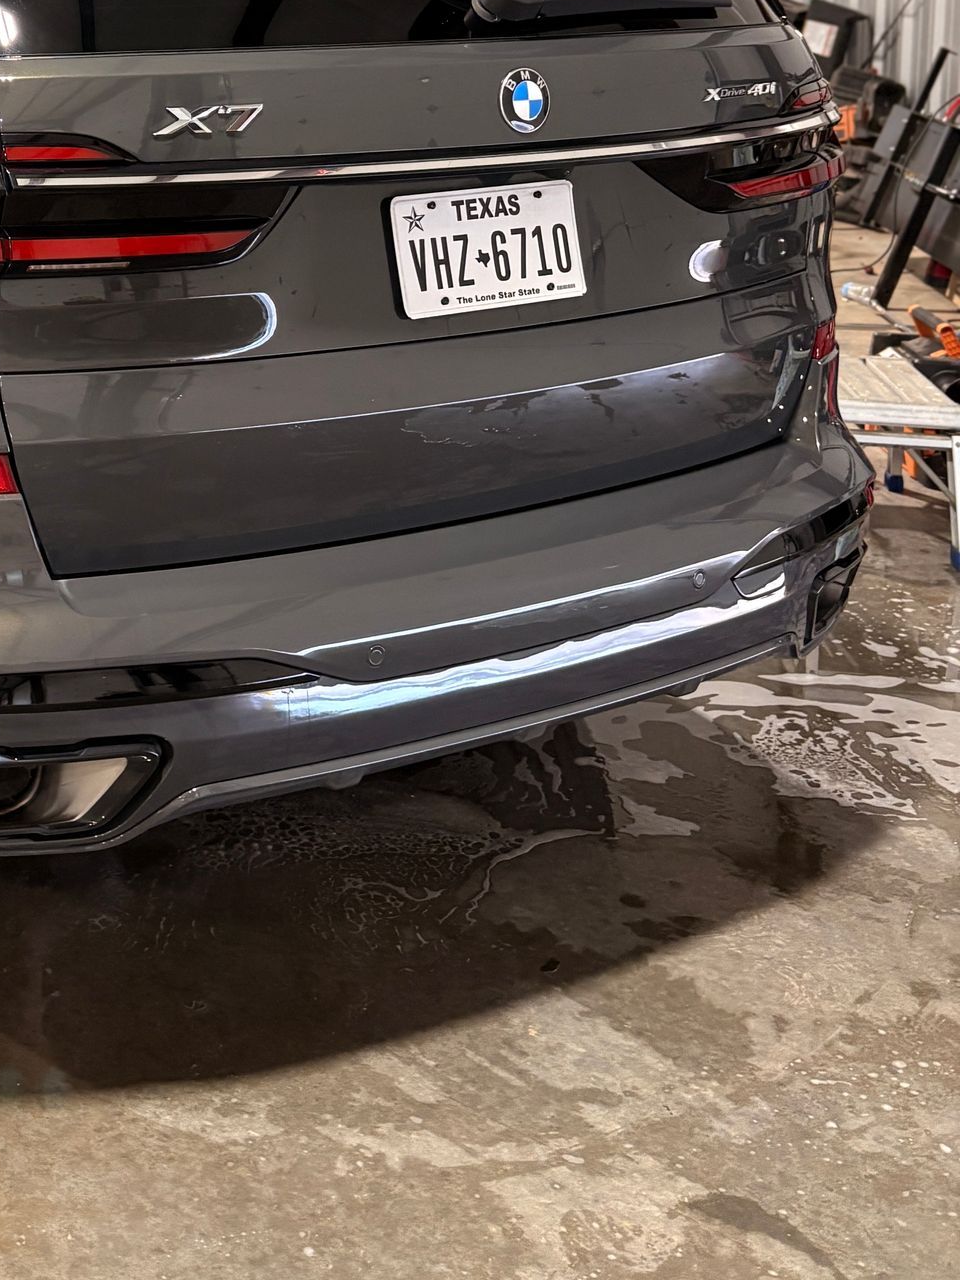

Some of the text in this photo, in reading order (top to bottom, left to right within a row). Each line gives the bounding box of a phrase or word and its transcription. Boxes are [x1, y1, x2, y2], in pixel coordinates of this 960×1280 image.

[152, 103, 264, 136] X7
[451, 194, 521, 221] TEXAS
[408, 223, 572, 292] VHZ 6710
[456, 287, 540, 305] The Lone Star State
